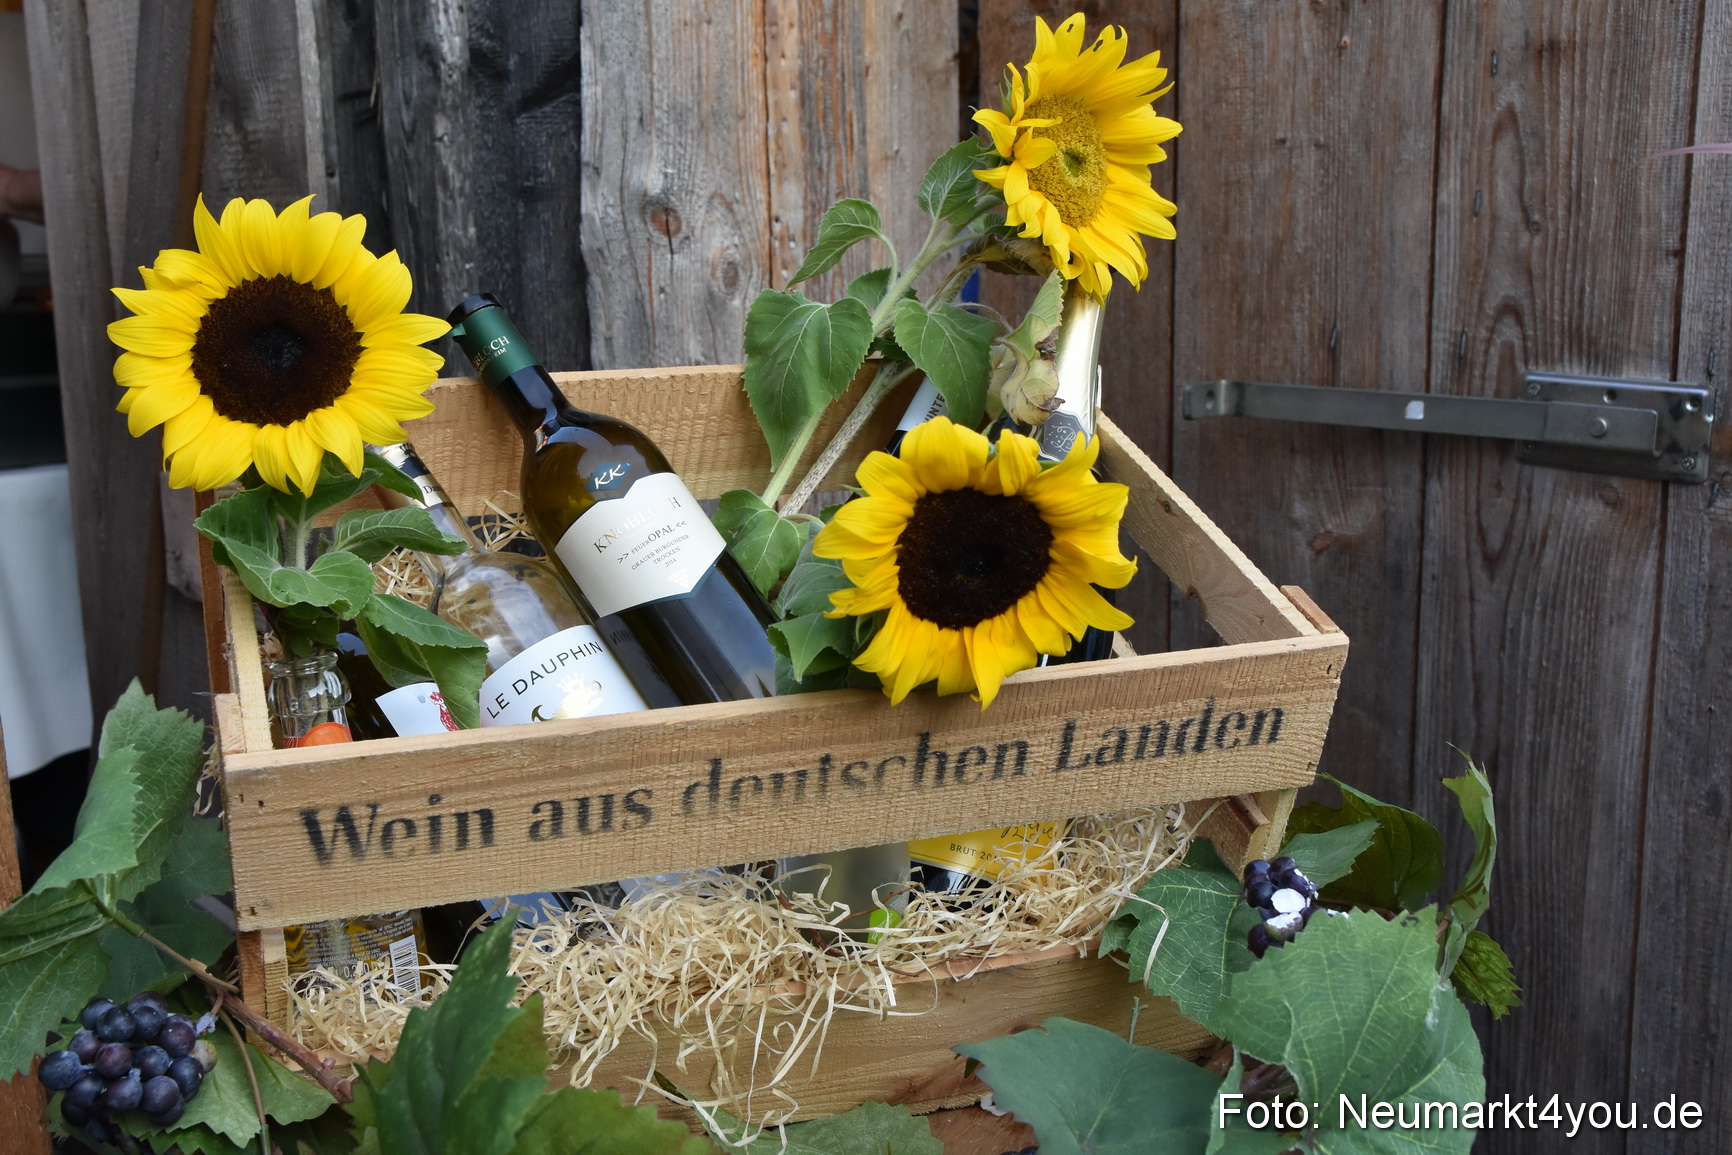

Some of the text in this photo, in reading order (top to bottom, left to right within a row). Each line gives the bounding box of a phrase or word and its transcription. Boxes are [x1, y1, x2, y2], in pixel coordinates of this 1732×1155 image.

[593, 496, 682, 554] KNOBLOH
[631, 534, 690, 571] GRAUER BURGUNDER
[652, 546, 681, 565] TROCKEN
[486, 640, 604, 719] LE DAUPHIN
[300, 794, 495, 867] Wein
[528, 788, 654, 842] aus
[682, 731, 1031, 816] deutschen
[949, 843, 977, 857] BRUT
